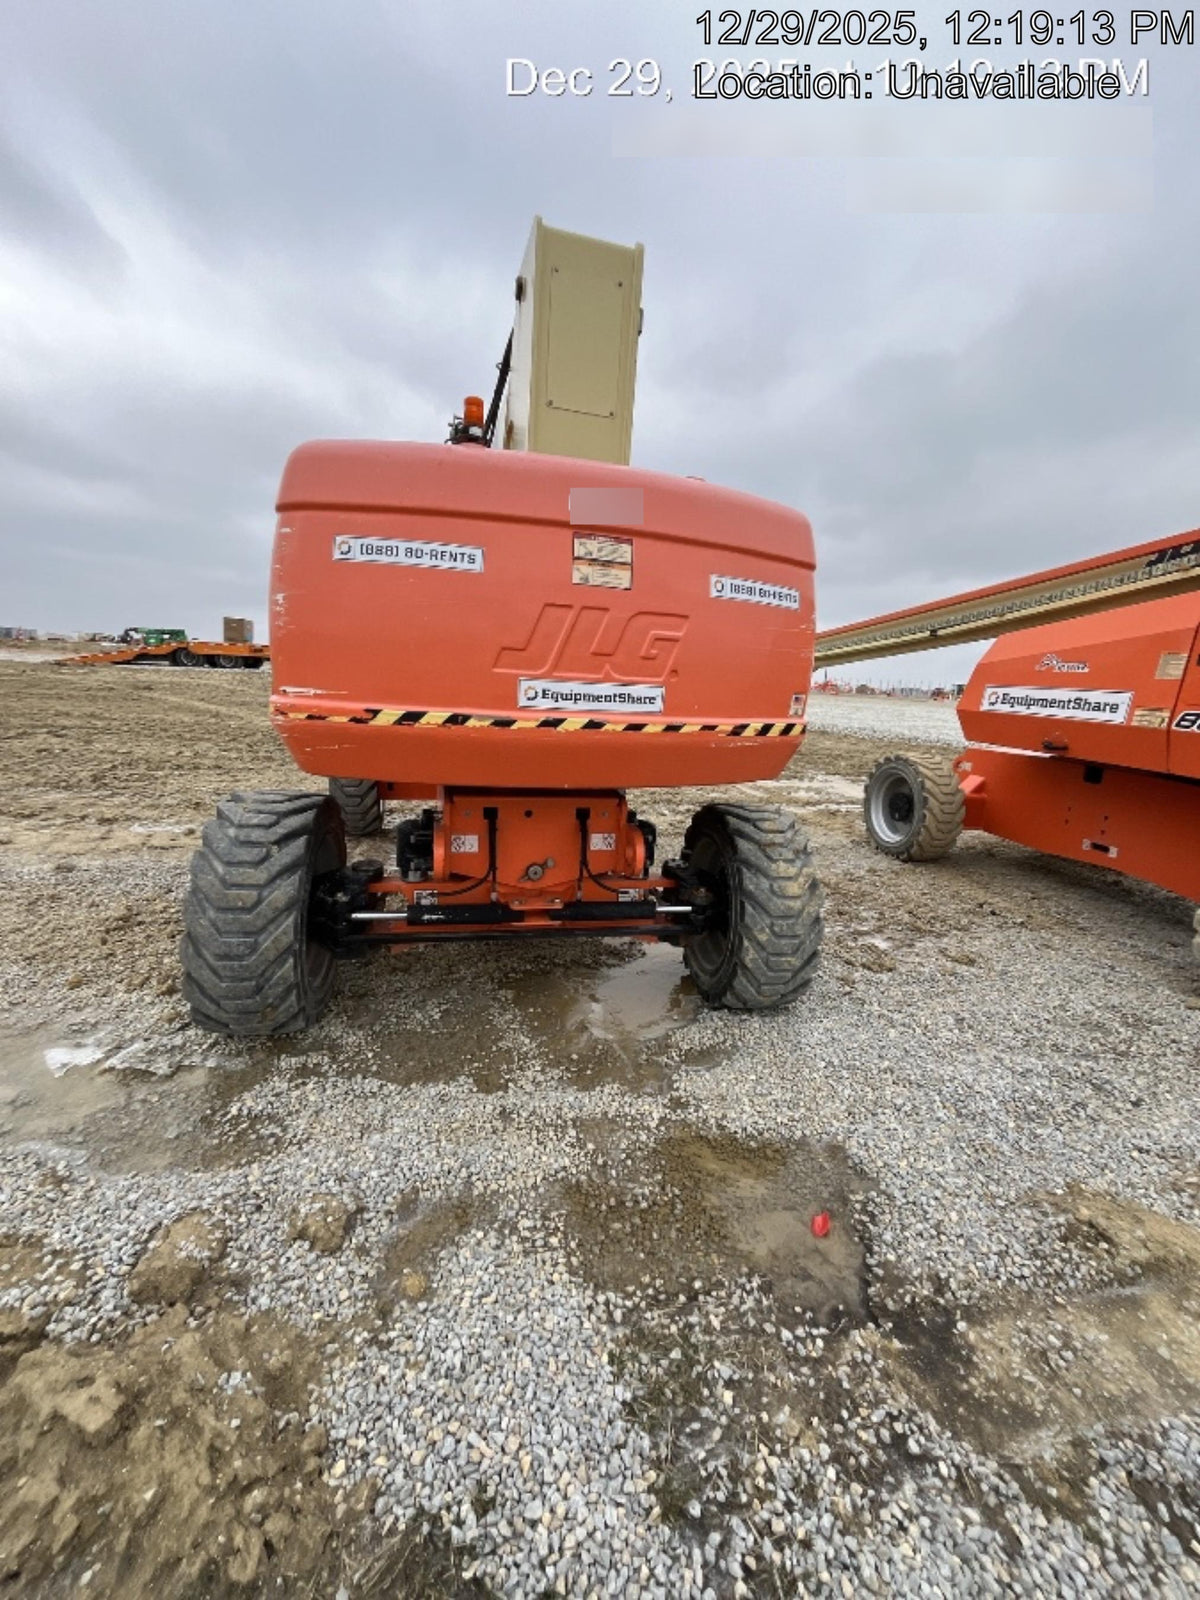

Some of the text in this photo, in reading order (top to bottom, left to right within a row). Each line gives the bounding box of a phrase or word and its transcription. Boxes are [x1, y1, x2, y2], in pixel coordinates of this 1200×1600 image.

[491, 602, 690, 682] JLG
[541, 687, 658, 705] EquipmentShare
[1000, 692, 1120, 714] EquipmentShare
[1173, 711, 1200, 731] 8
